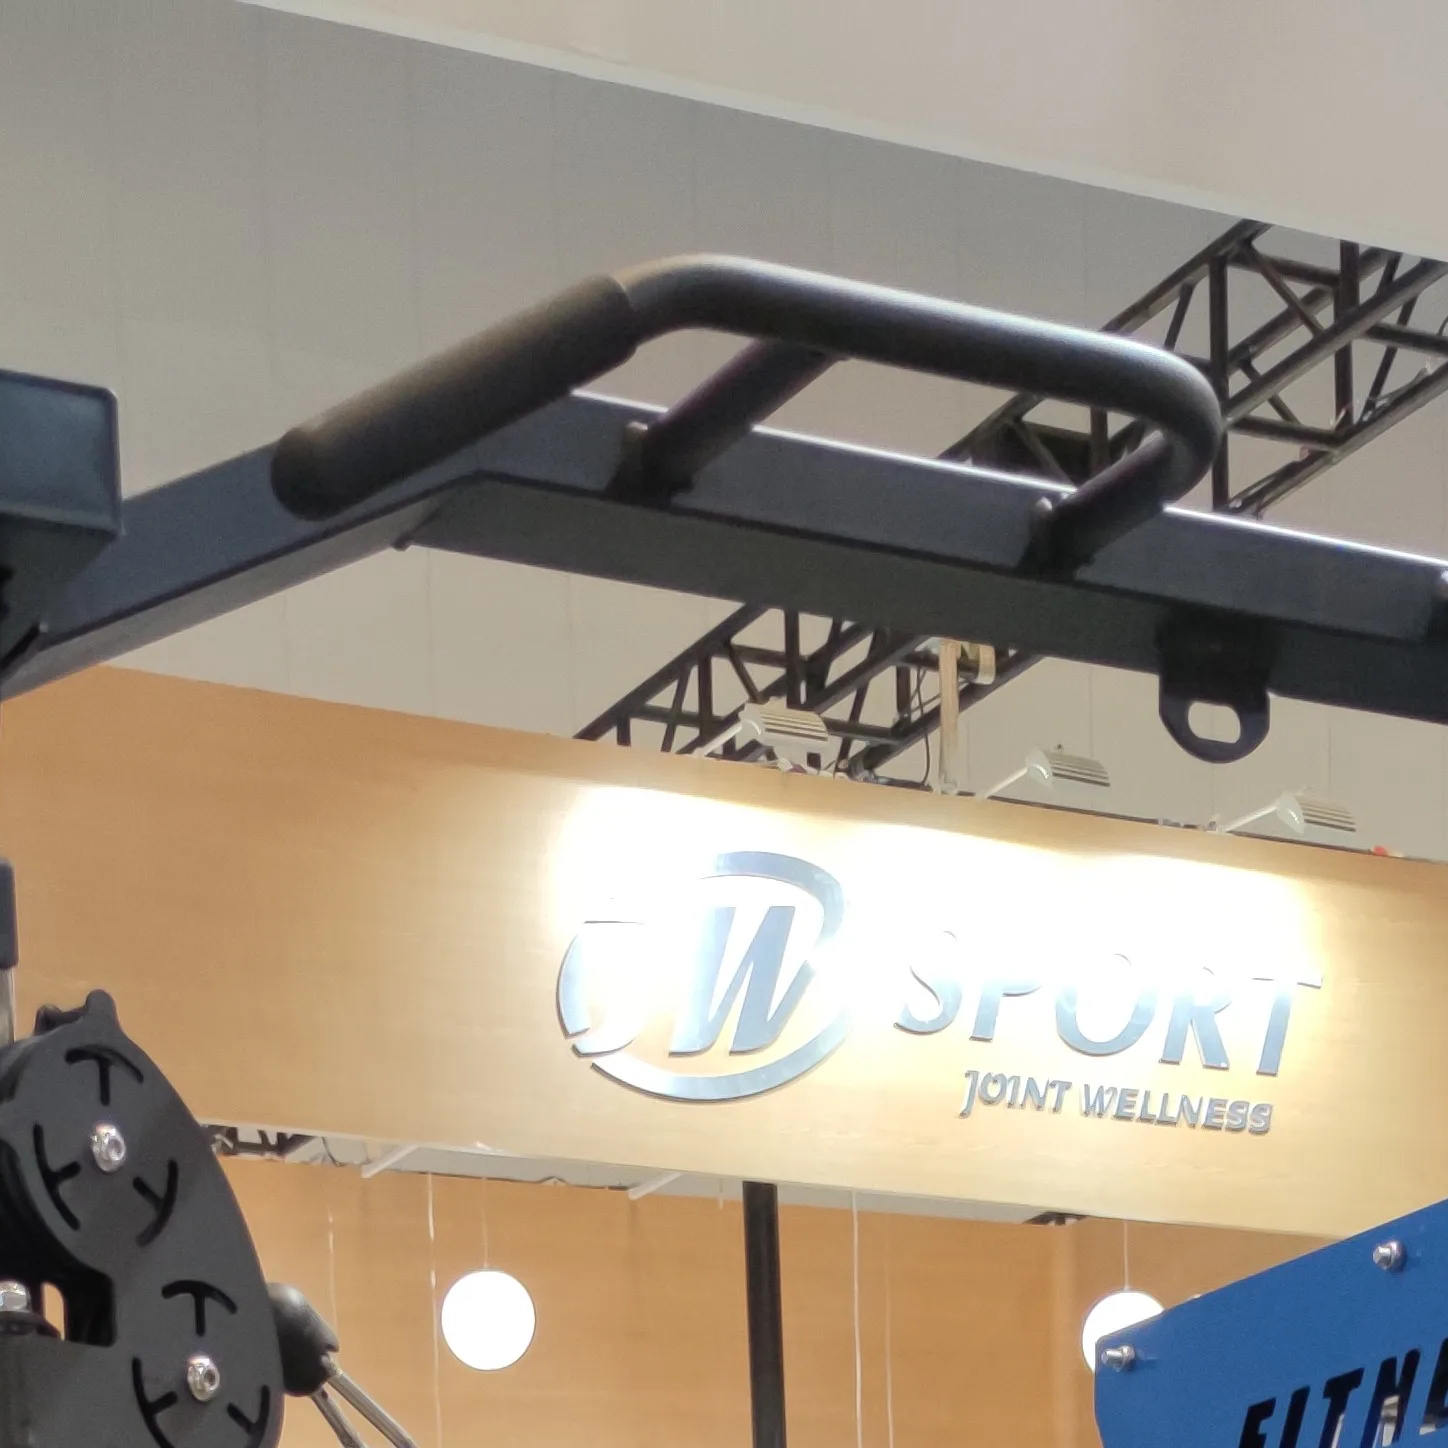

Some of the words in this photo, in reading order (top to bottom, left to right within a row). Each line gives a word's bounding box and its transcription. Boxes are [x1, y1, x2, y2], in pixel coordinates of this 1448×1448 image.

[895, 931, 1323, 1076] SPORT
[958, 1068, 1071, 1119] JOINT
[1081, 1080, 1274, 1134] WELLNESS
